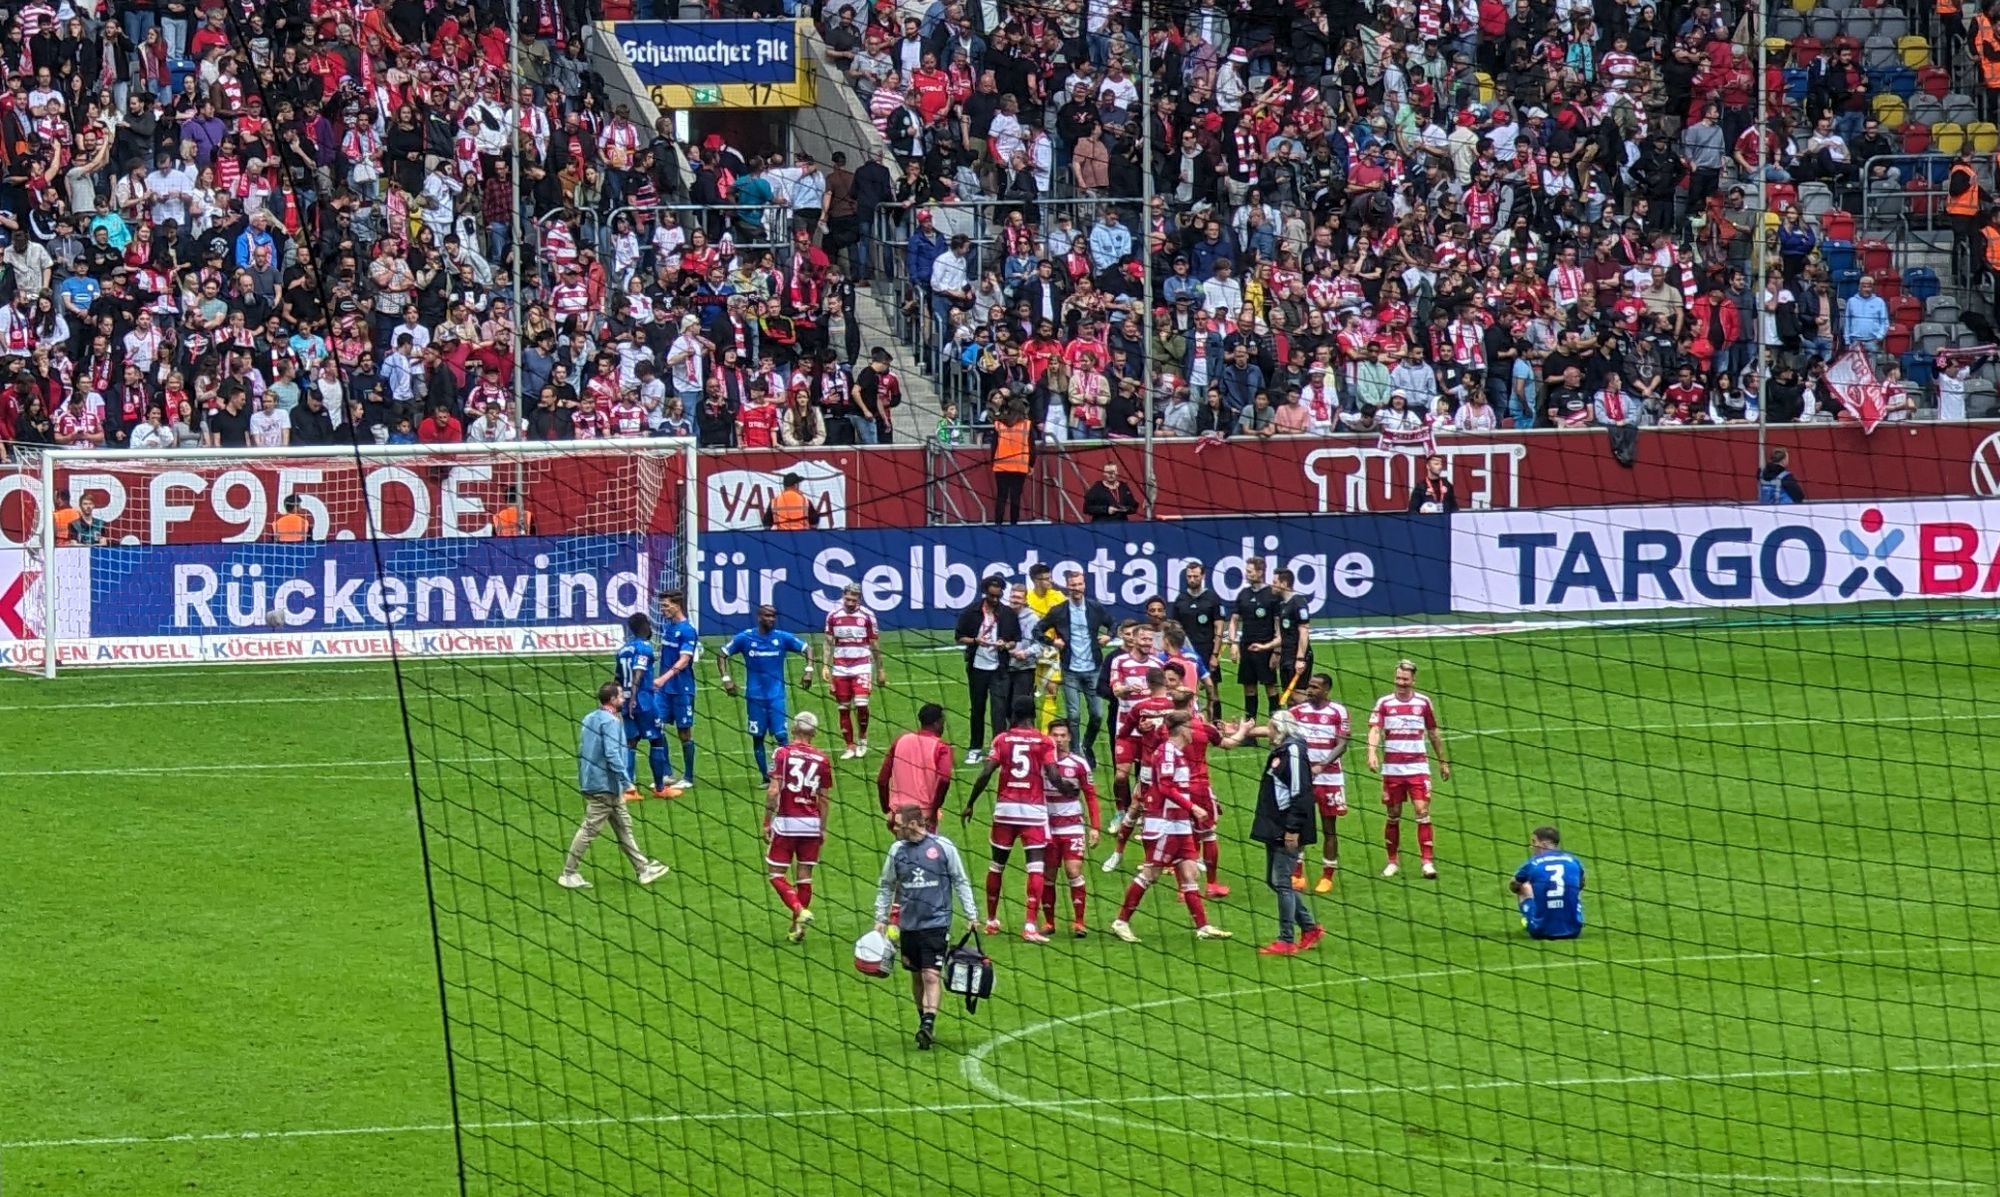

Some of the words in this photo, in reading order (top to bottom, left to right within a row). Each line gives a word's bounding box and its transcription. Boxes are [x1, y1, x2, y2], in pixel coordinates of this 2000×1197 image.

[623, 39, 751, 67] Schumacher
[756, 38, 788, 66] Alt
[651, 85, 664, 107] 6
[749, 84, 771, 105] 17
[719, 481, 835, 530] YAA
[1498, 525, 1827, 605] TARGO
[174, 552, 649, 628] Rückenwind
[96, 640, 193, 660] AKTUELL
[213, 637, 304, 658] KÜCHEN
[311, 637, 402, 655] AKTUELL
[422, 633, 514, 652] KÜCHEN
[521, 631, 617, 650] AKTUELL
[787, 757, 821, 796] 34
[1010, 744, 1030, 778] 5
[1545, 864, 1565, 897] 3
